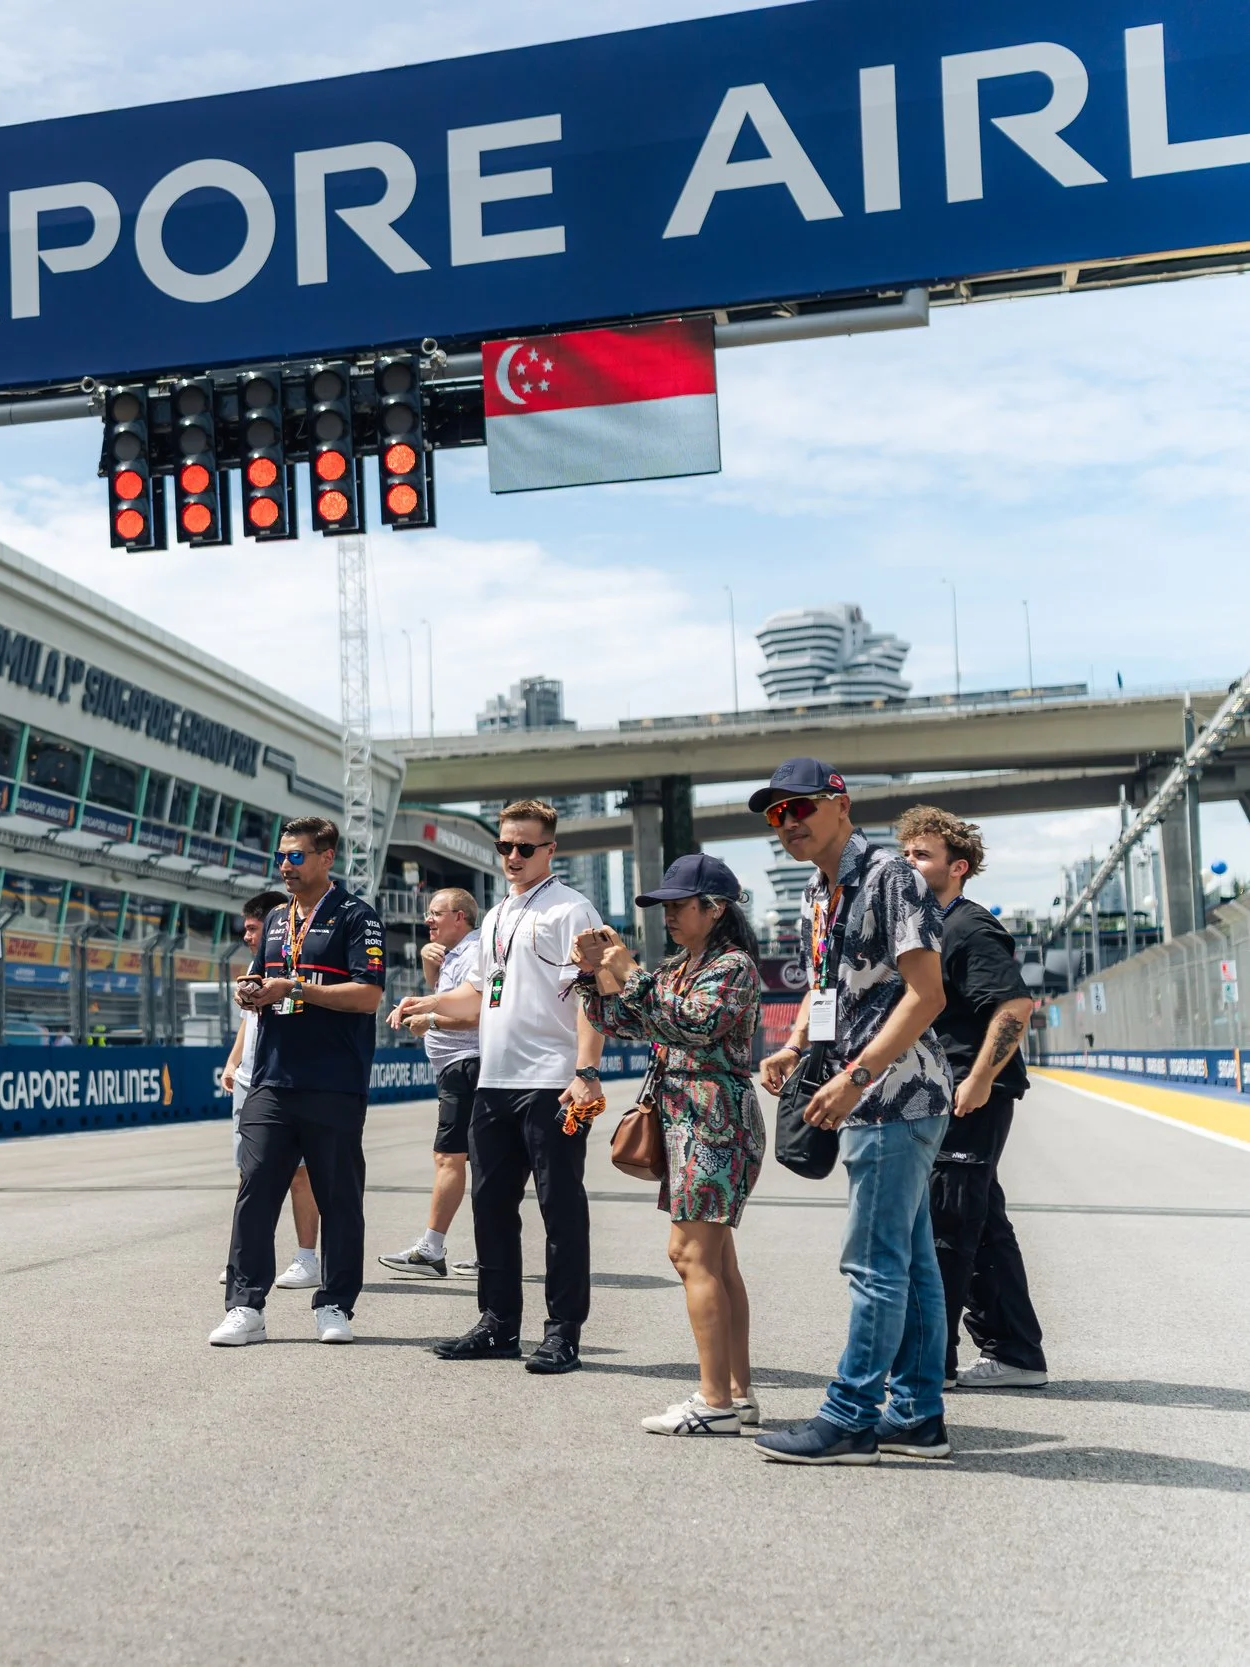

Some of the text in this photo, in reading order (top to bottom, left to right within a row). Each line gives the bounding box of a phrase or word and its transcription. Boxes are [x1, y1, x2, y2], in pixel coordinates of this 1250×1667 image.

[661, 23, 1250, 239] AIRL
[82, 665, 183, 748] SINGAPORE
[178, 707, 233, 769] GRAND
[231, 729, 262, 778] PRIX
[365, 920, 381, 928] VISA
[85, 1067, 160, 1107] AIRLINES
[412, 1061, 436, 1086] AIRLIN
